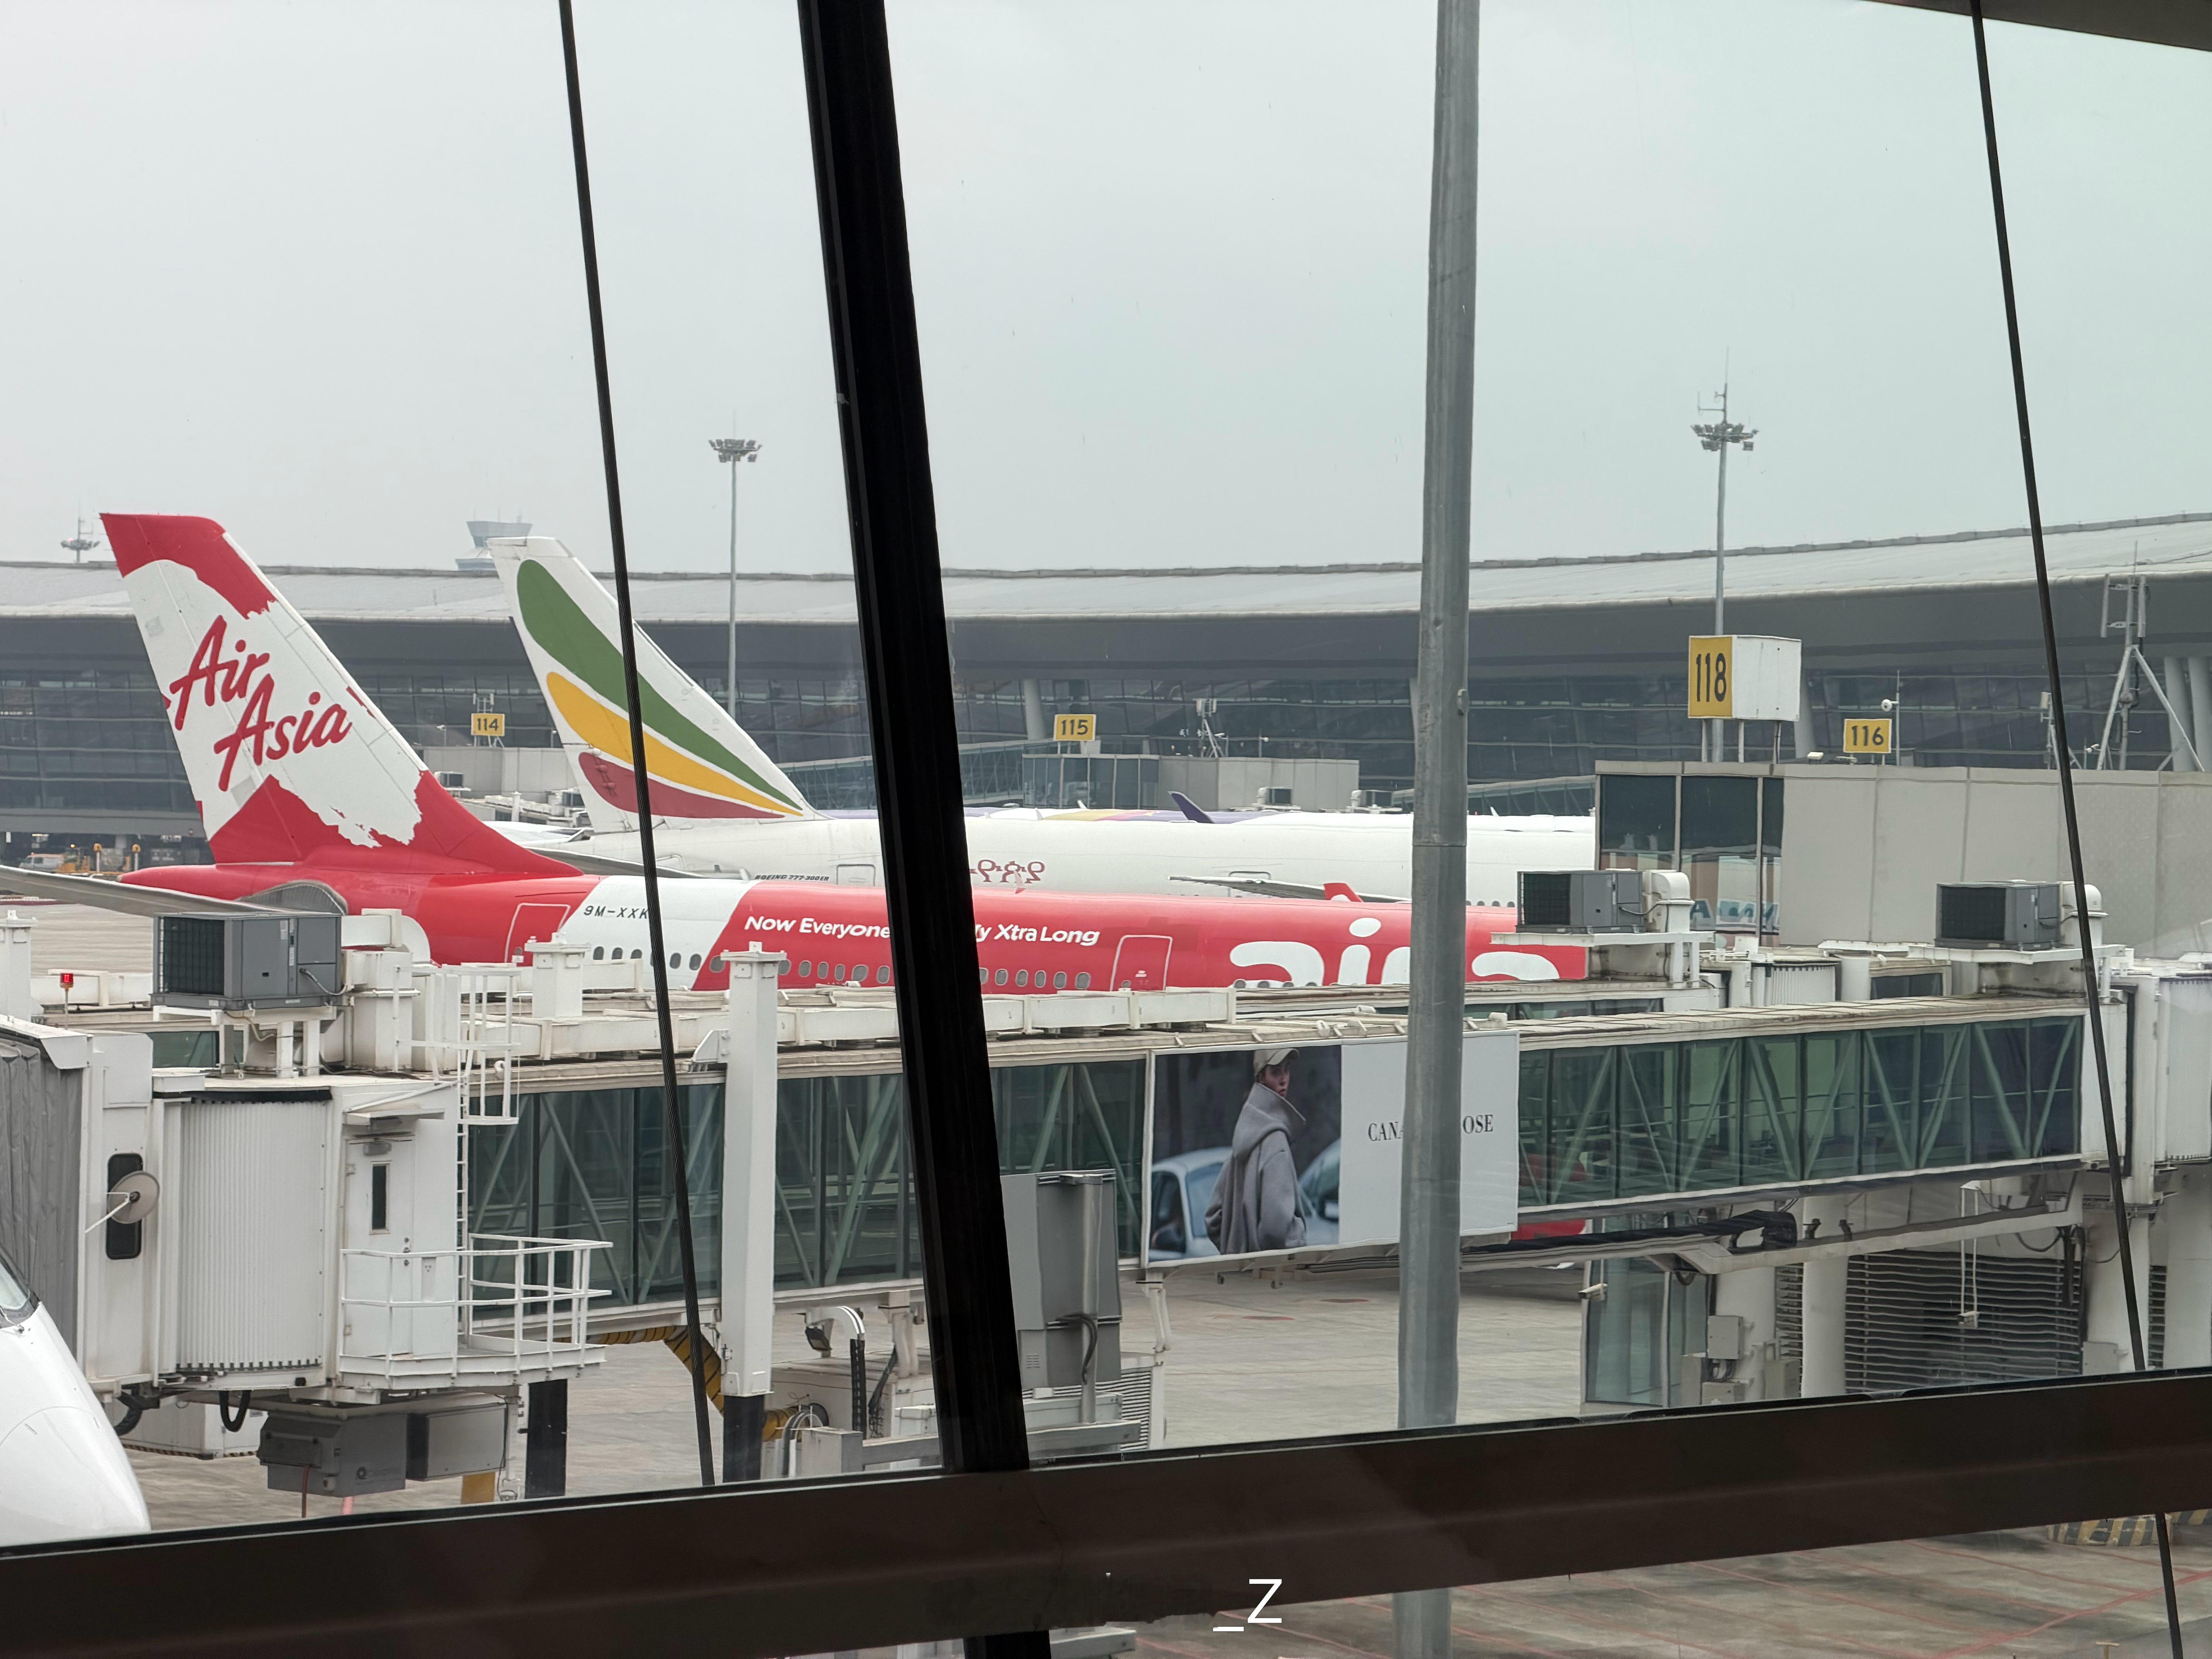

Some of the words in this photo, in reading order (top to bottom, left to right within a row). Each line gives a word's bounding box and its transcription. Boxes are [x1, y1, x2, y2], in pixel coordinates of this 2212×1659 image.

[170, 615, 270, 730] Air
[1696, 653, 1726, 702] 118
[214, 673, 352, 792] Asia
[477, 718, 498, 731] 114
[1061, 719, 1088, 735] 115
[1851, 725, 1884, 746] 116
[584, 905, 649, 919] 9M-XXK
[745, 916, 797, 932] Now
[799, 917, 890, 939] Everyone
[1368, 1121, 1404, 1142] CAN
[1463, 1115, 1493, 1134] OSE
